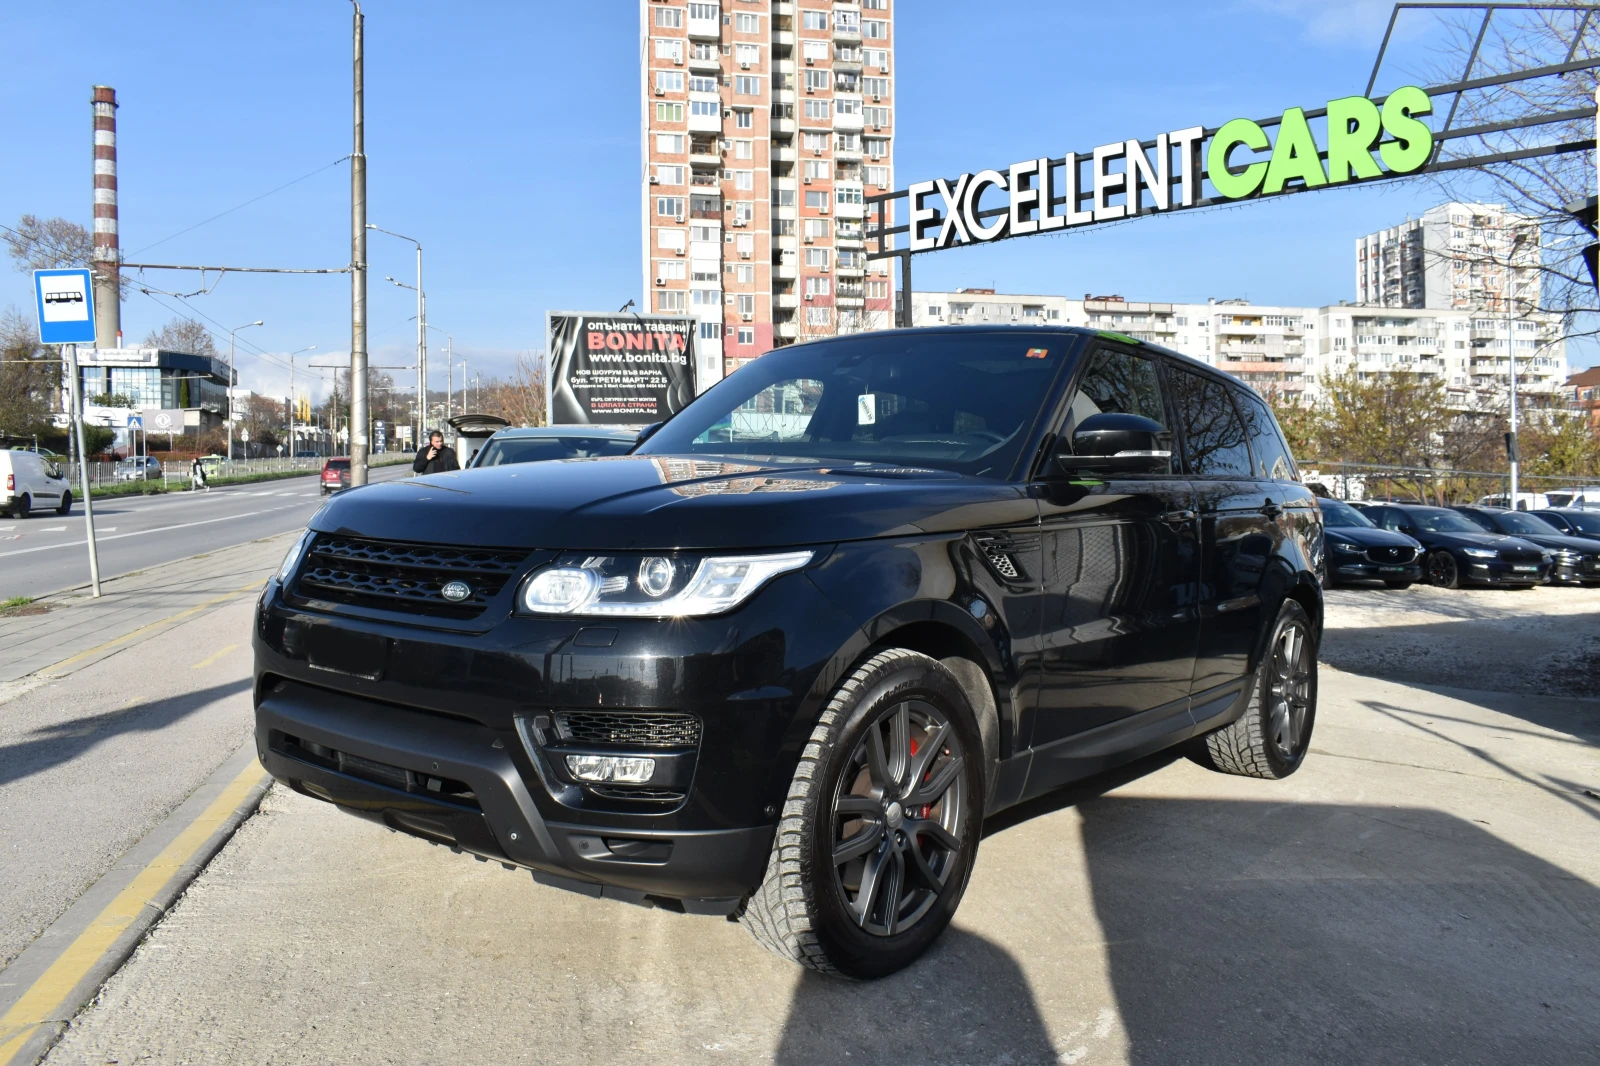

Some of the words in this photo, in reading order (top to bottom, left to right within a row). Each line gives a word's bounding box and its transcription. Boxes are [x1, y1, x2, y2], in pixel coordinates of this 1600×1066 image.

[909, 125, 1203, 252] EXCELLENT
[1207, 86, 1433, 199] CARS
[588, 322, 641, 331] опънати
[644, 323, 685, 332] тавани
[588, 332, 686, 350] BONITA
[589, 353, 686, 365] www.bonita.bg
